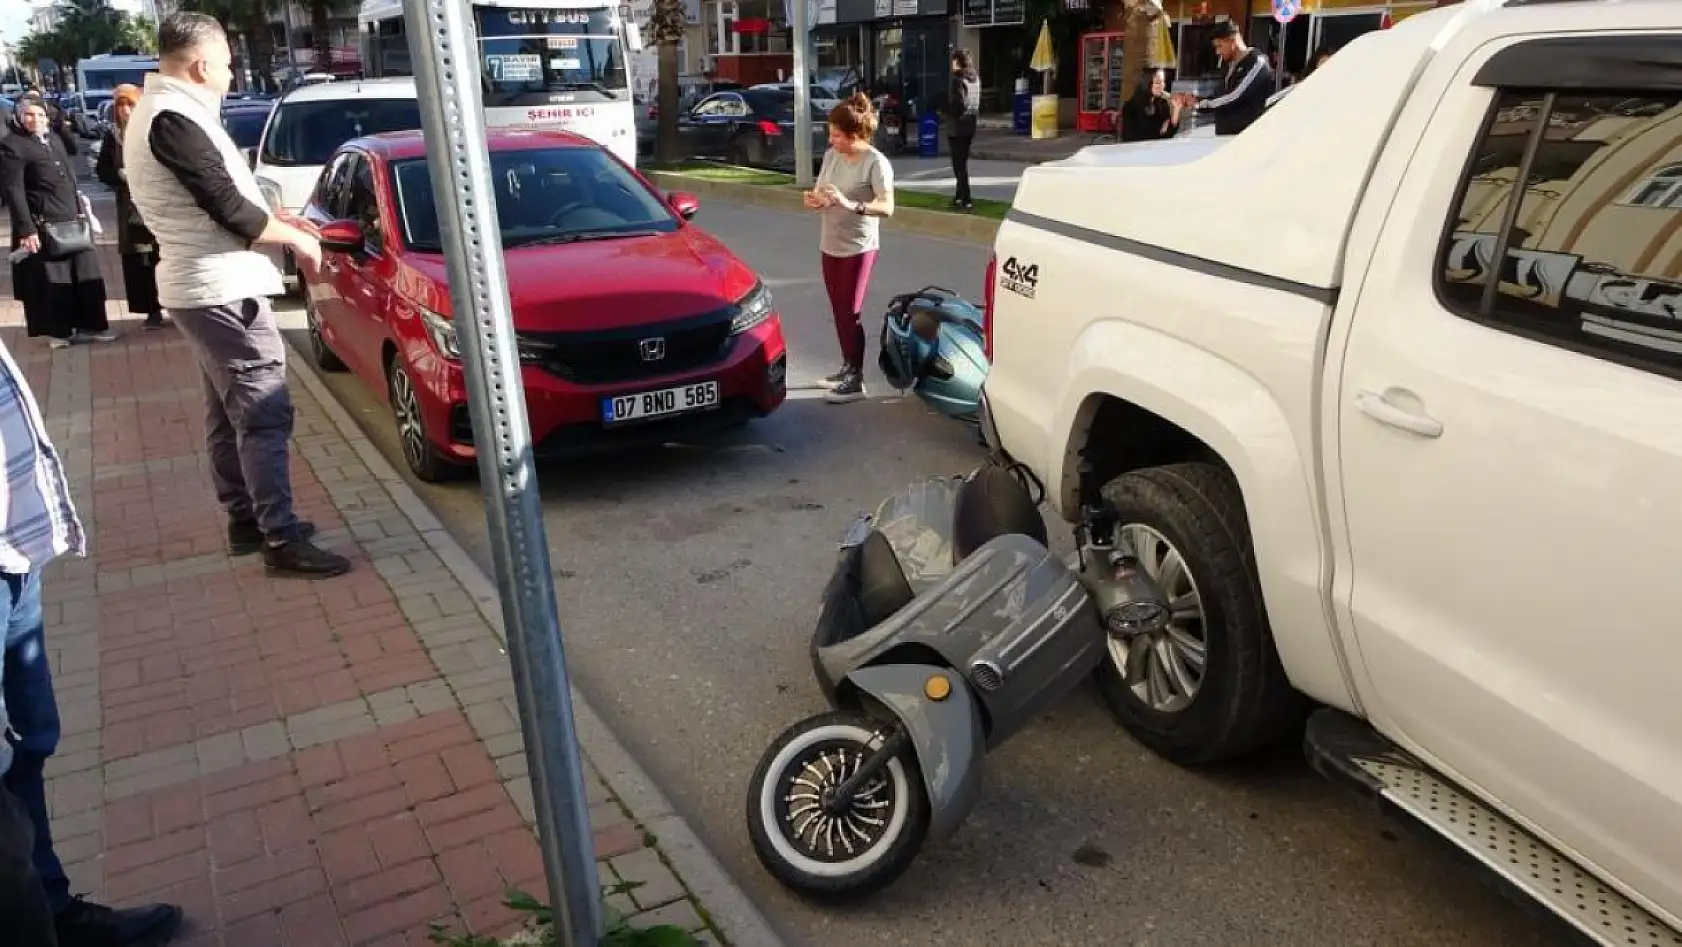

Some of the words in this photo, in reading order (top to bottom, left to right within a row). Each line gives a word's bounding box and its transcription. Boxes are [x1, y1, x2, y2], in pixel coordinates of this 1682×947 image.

[507, 10, 549, 24] CITY
[555, 10, 589, 24] BUS
[615, 396, 636, 419] 07
[643, 390, 675, 414] BND
[685, 383, 715, 407] 585
